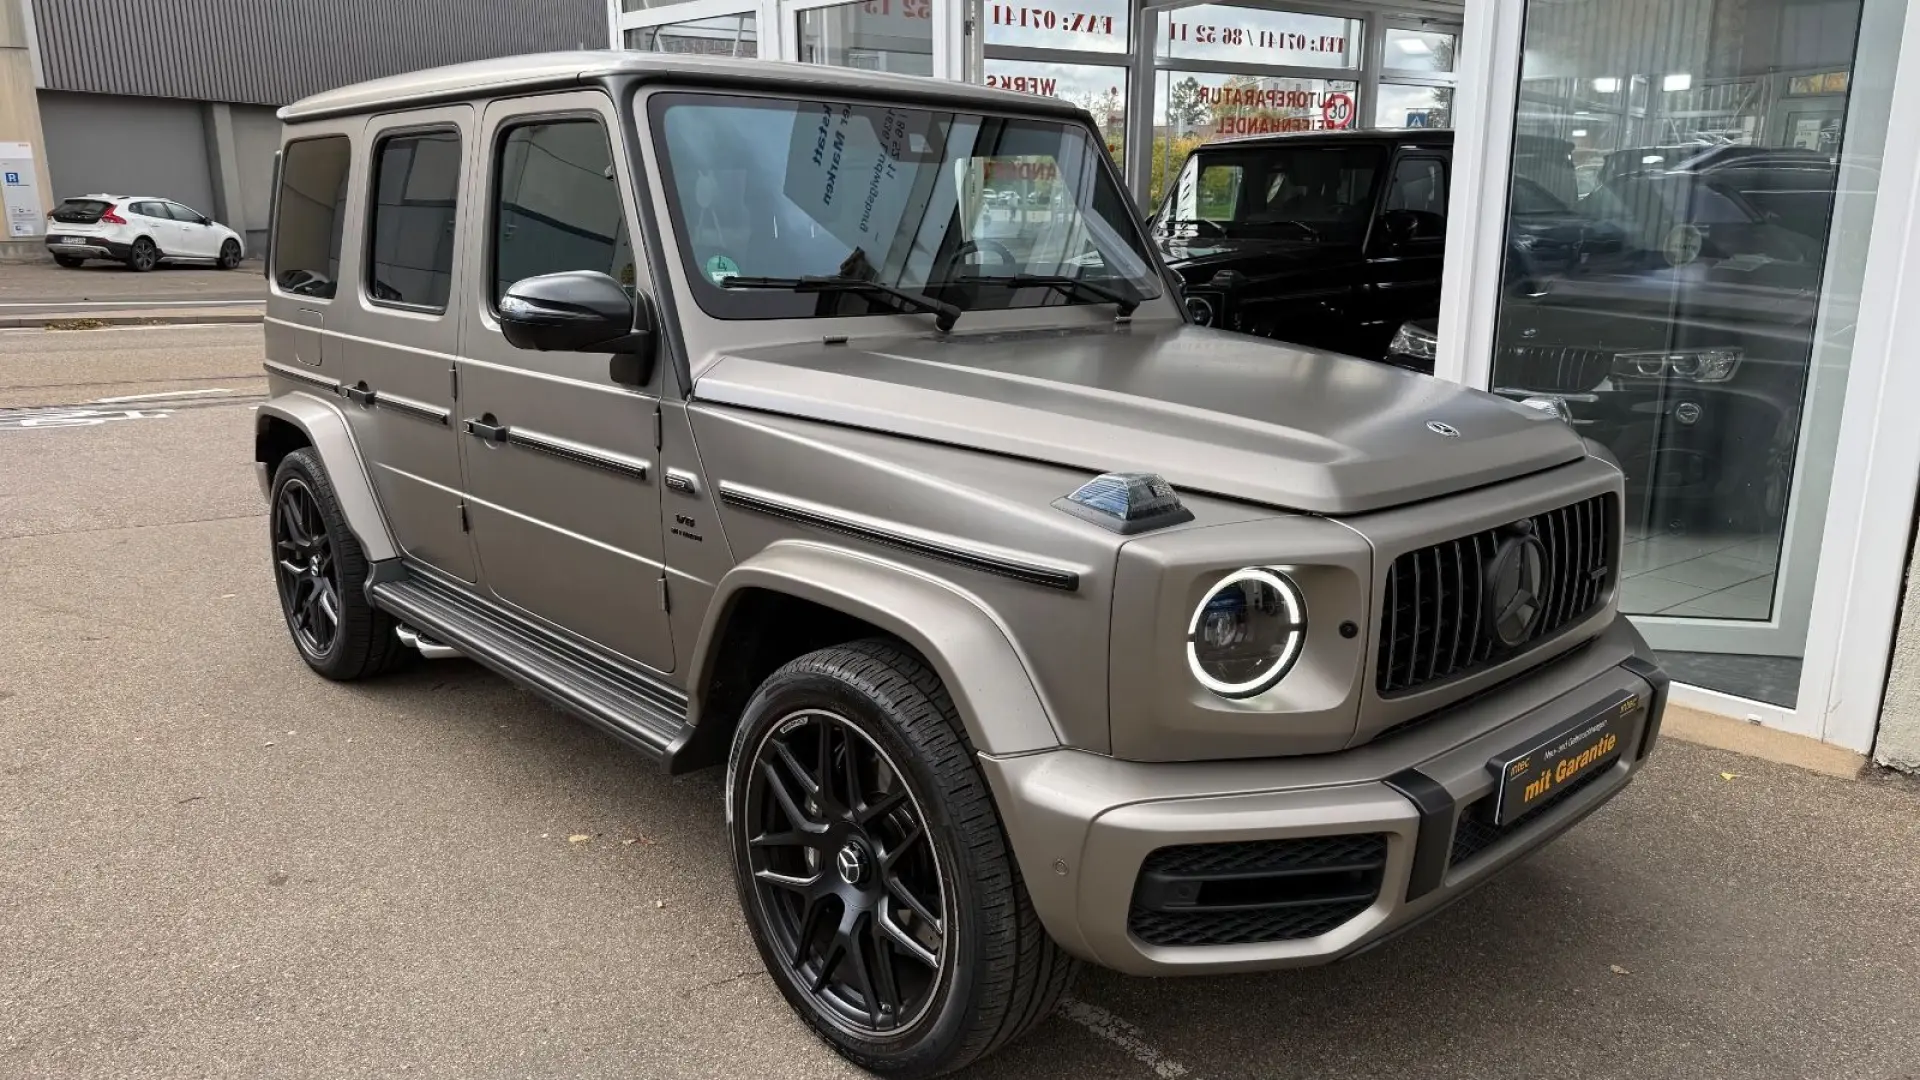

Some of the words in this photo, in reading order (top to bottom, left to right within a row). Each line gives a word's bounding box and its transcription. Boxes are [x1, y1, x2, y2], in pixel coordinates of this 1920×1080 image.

[1329, 104, 1346, 120] 30
[1524, 768, 1551, 802] mit
[1555, 732, 1616, 783] Garantie
